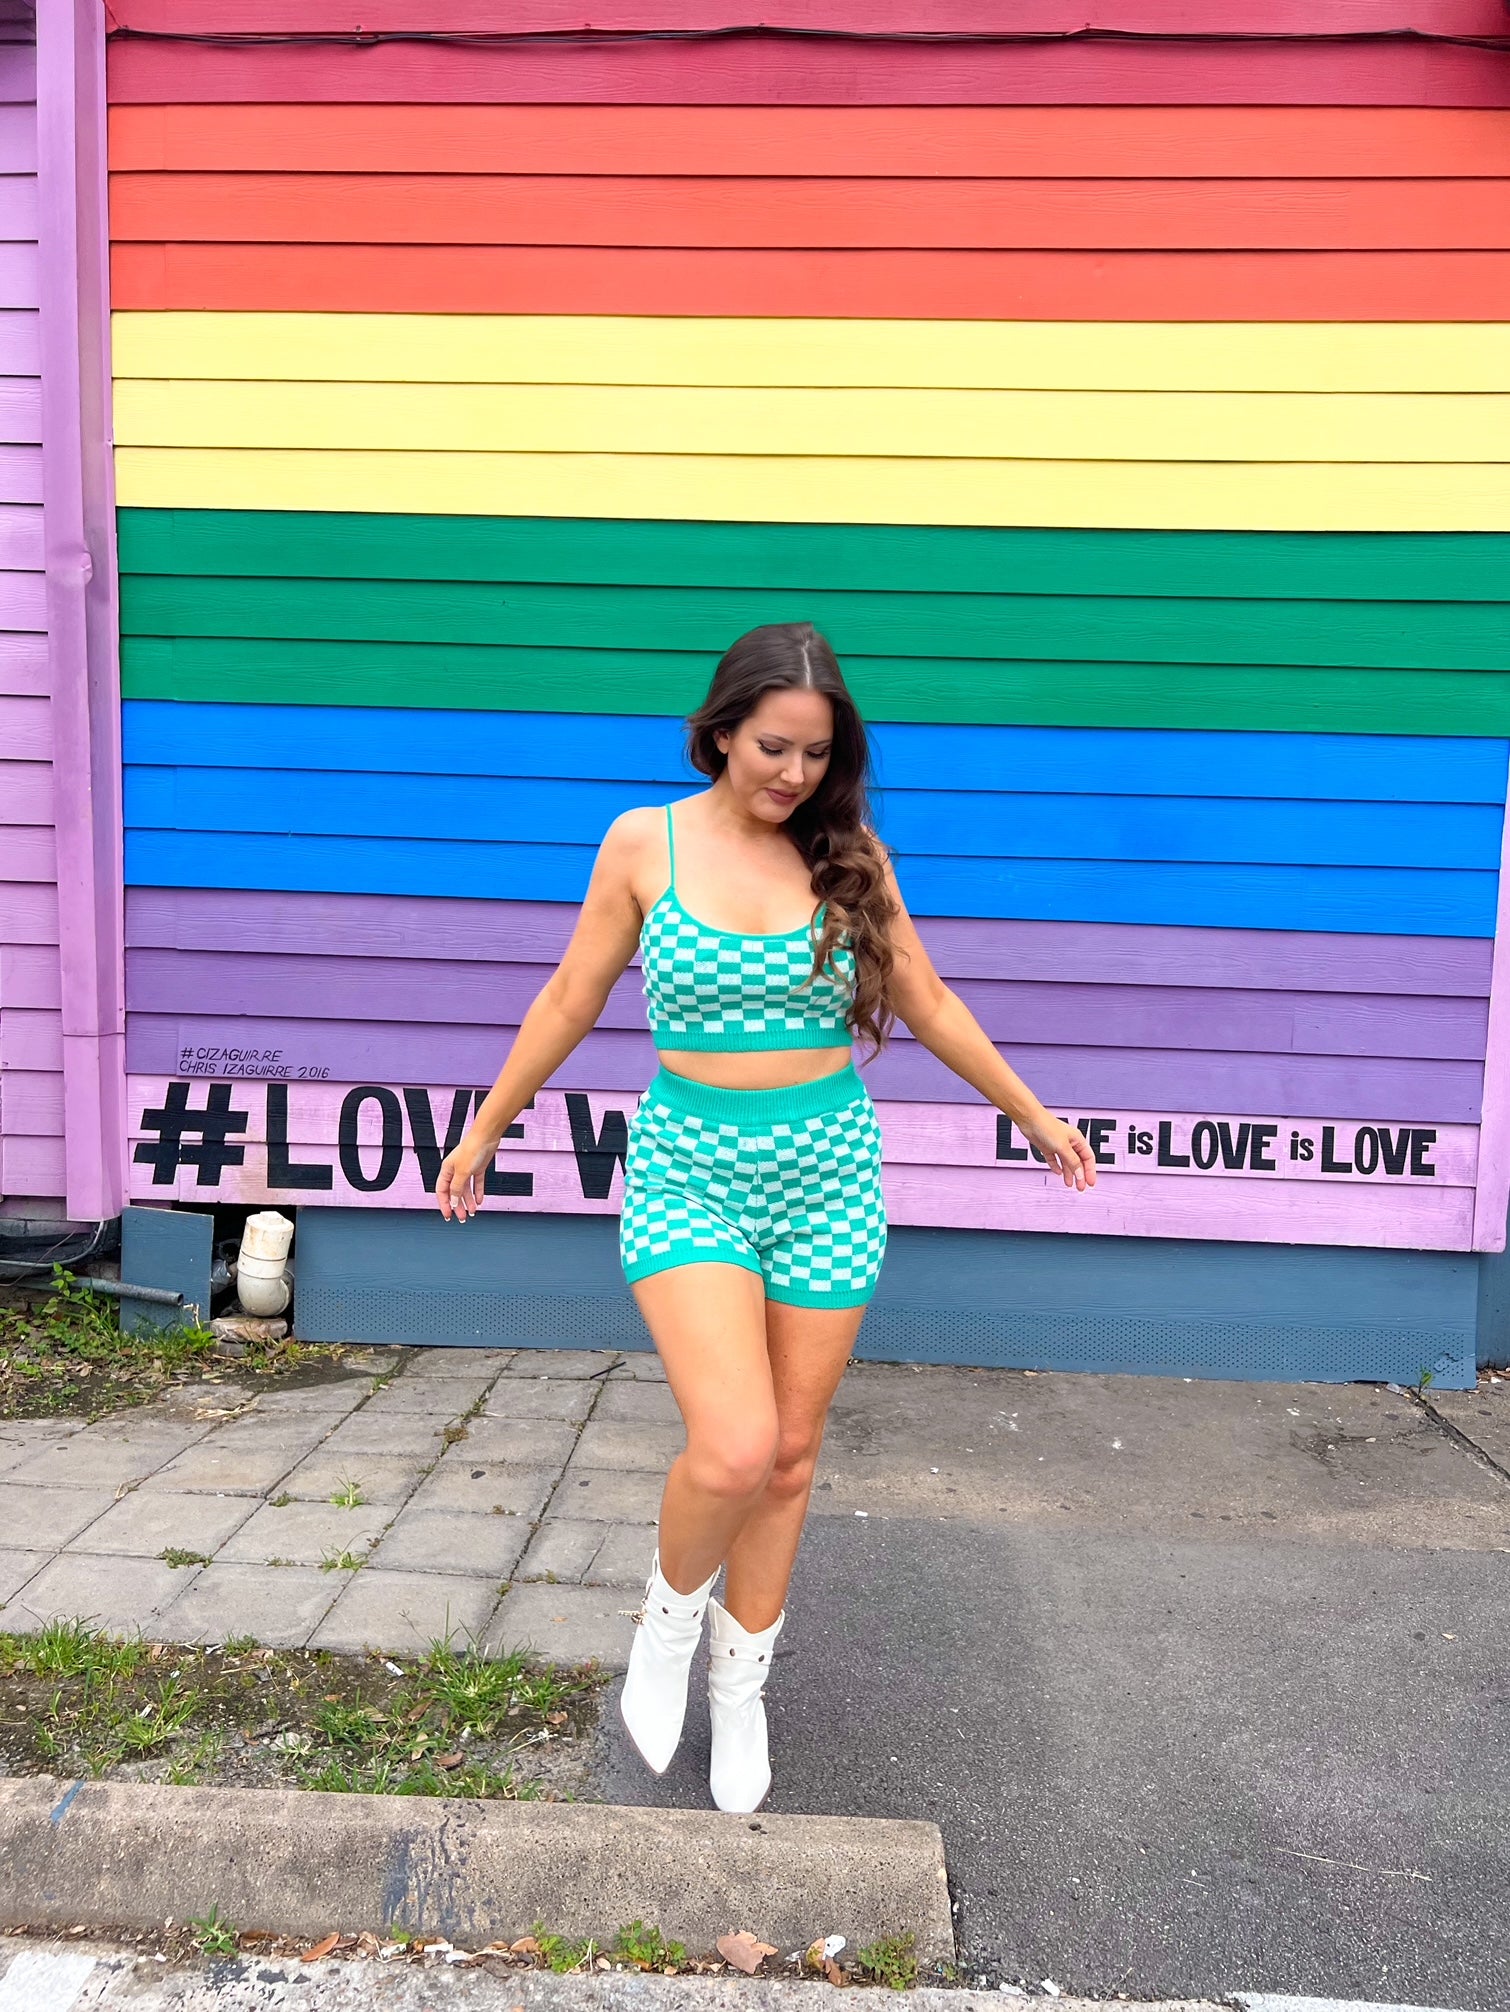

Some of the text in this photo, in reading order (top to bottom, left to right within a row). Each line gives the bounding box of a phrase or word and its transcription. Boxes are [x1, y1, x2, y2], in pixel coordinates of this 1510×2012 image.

[179, 1060, 330, 1079] CHRIS IZAGUIRRE 2016
[1128, 1125, 1154, 1155] is
[1158, 1120, 1278, 1171] LOVE
[1291, 1131, 1314, 1161] is
[1321, 1126, 1437, 1176] LOVE
